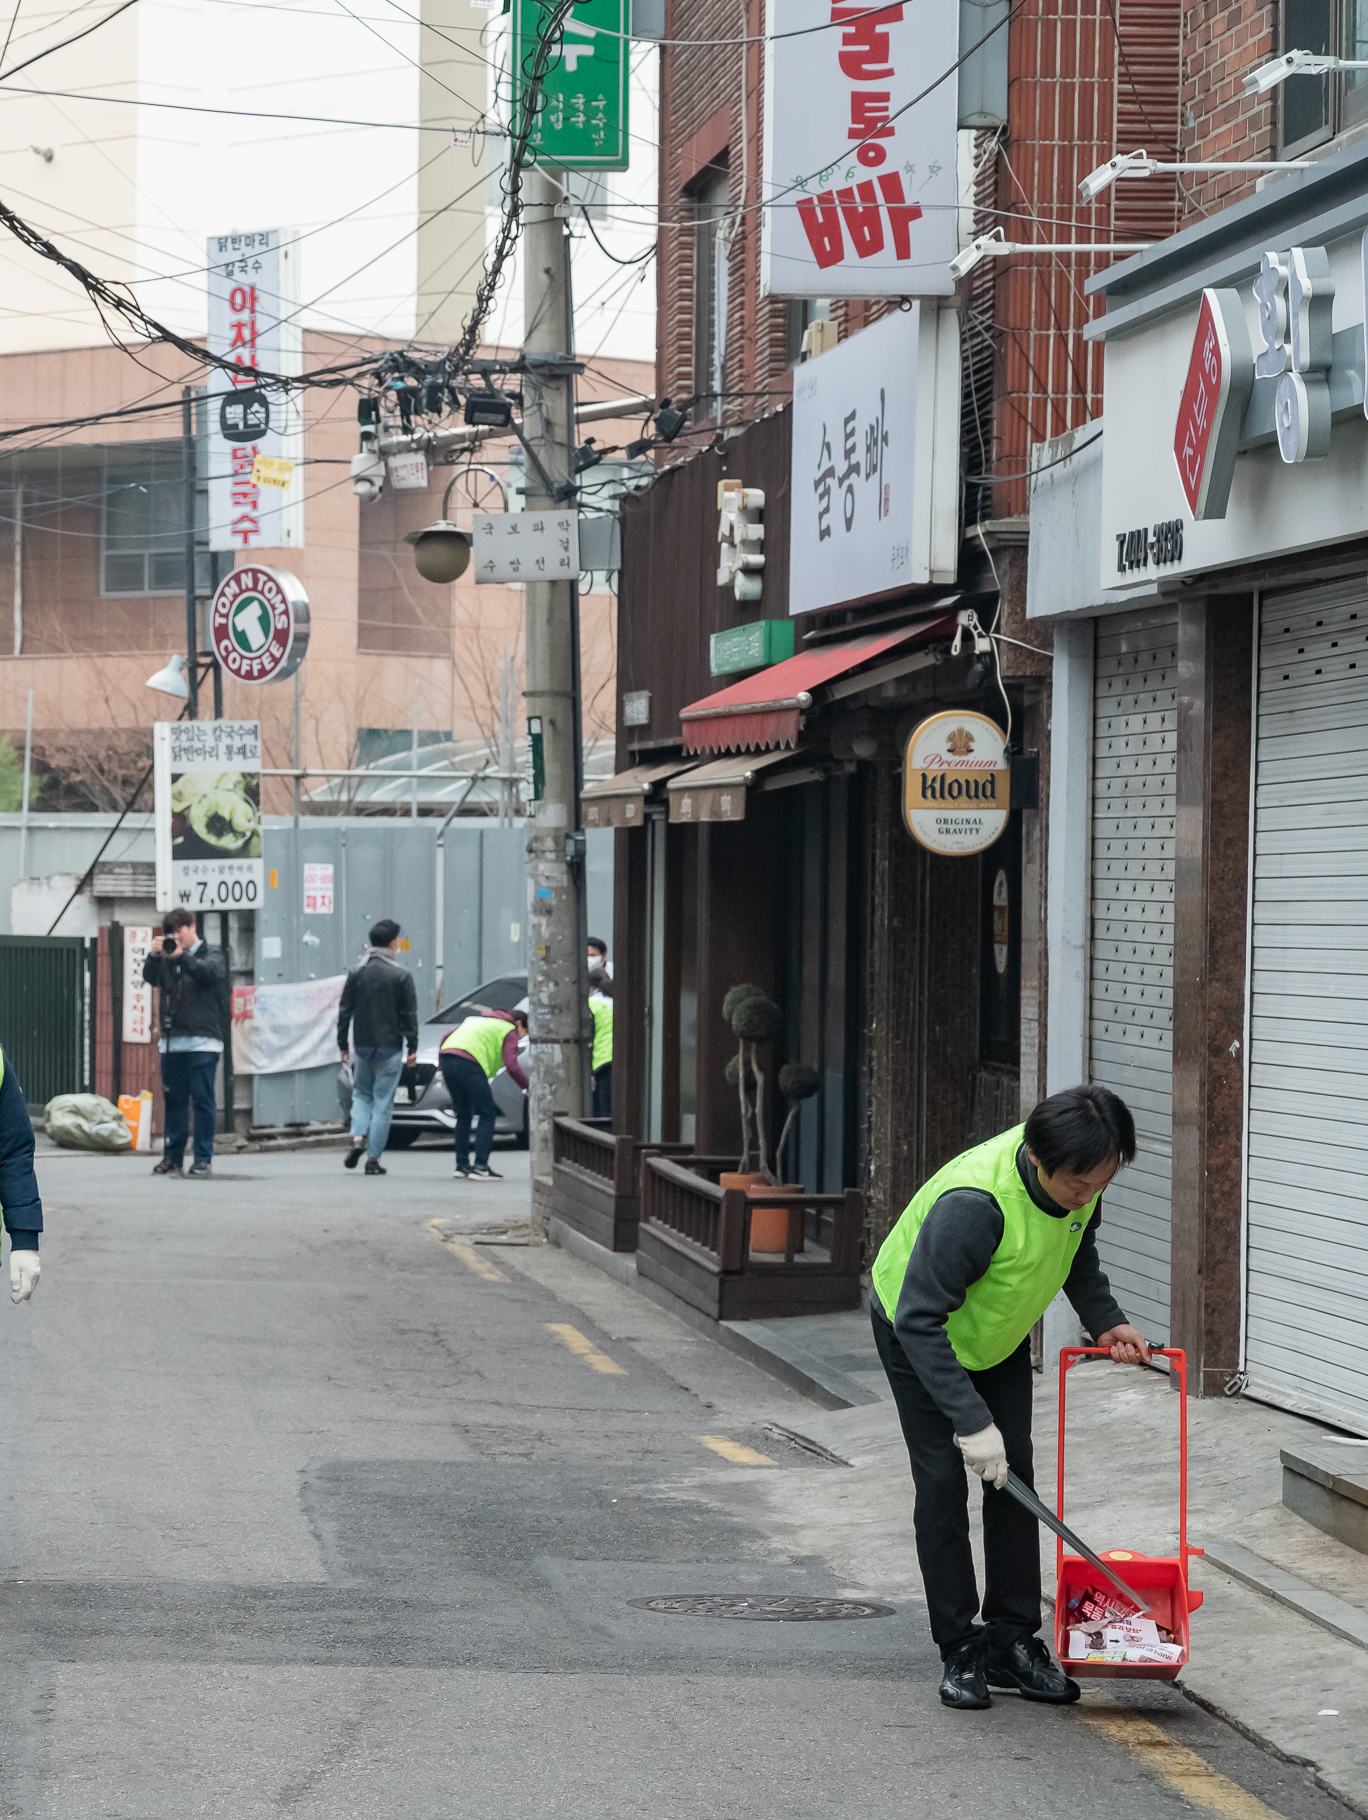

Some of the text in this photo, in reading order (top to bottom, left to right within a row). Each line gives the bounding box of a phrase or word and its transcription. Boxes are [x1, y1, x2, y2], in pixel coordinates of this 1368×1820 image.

[217, 231, 270, 252] 닭반마리
[229, 284, 260, 386] 아차산
[1252, 228, 1368, 464] 황
[812, 387, 890, 543] 술통빠
[214, 571, 289, 630] TOM N TOMS
[219, 638, 284, 678] COFFEE
[171, 744, 220, 762] 닭반마리
[921, 753, 999, 770] Premium
[935, 816, 984, 826] ORIGINAL
[937, 826, 982, 836] GRAVITY
